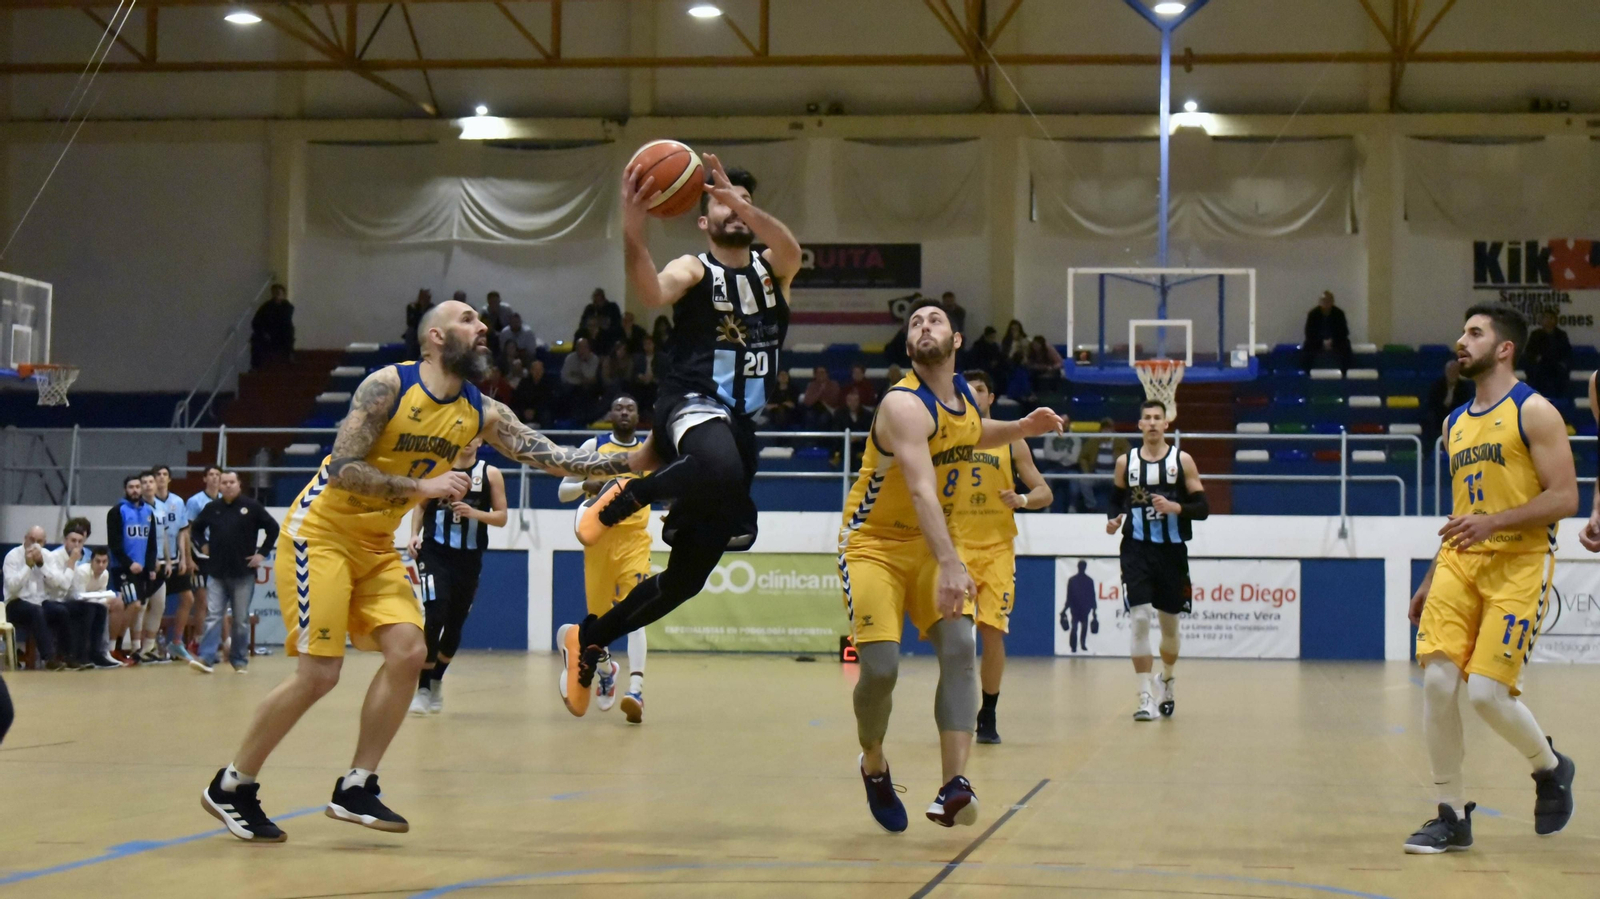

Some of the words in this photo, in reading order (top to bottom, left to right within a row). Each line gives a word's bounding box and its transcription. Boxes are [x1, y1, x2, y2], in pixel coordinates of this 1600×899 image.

[743, 351, 769, 376] 20
[943, 469, 959, 497] 8
[972, 467, 982, 487] 5
[1463, 471, 1484, 505] 11
[757, 570, 820, 590] clínica
[1098, 582, 1119, 600] La
[1001, 592, 1010, 611] 5
[1211, 583, 1234, 603] de
[1240, 583, 1297, 608] Diego
[1202, 610, 1250, 621] Sánchez
[1253, 610, 1281, 621] Vera
[1502, 614, 1530, 651] 11
